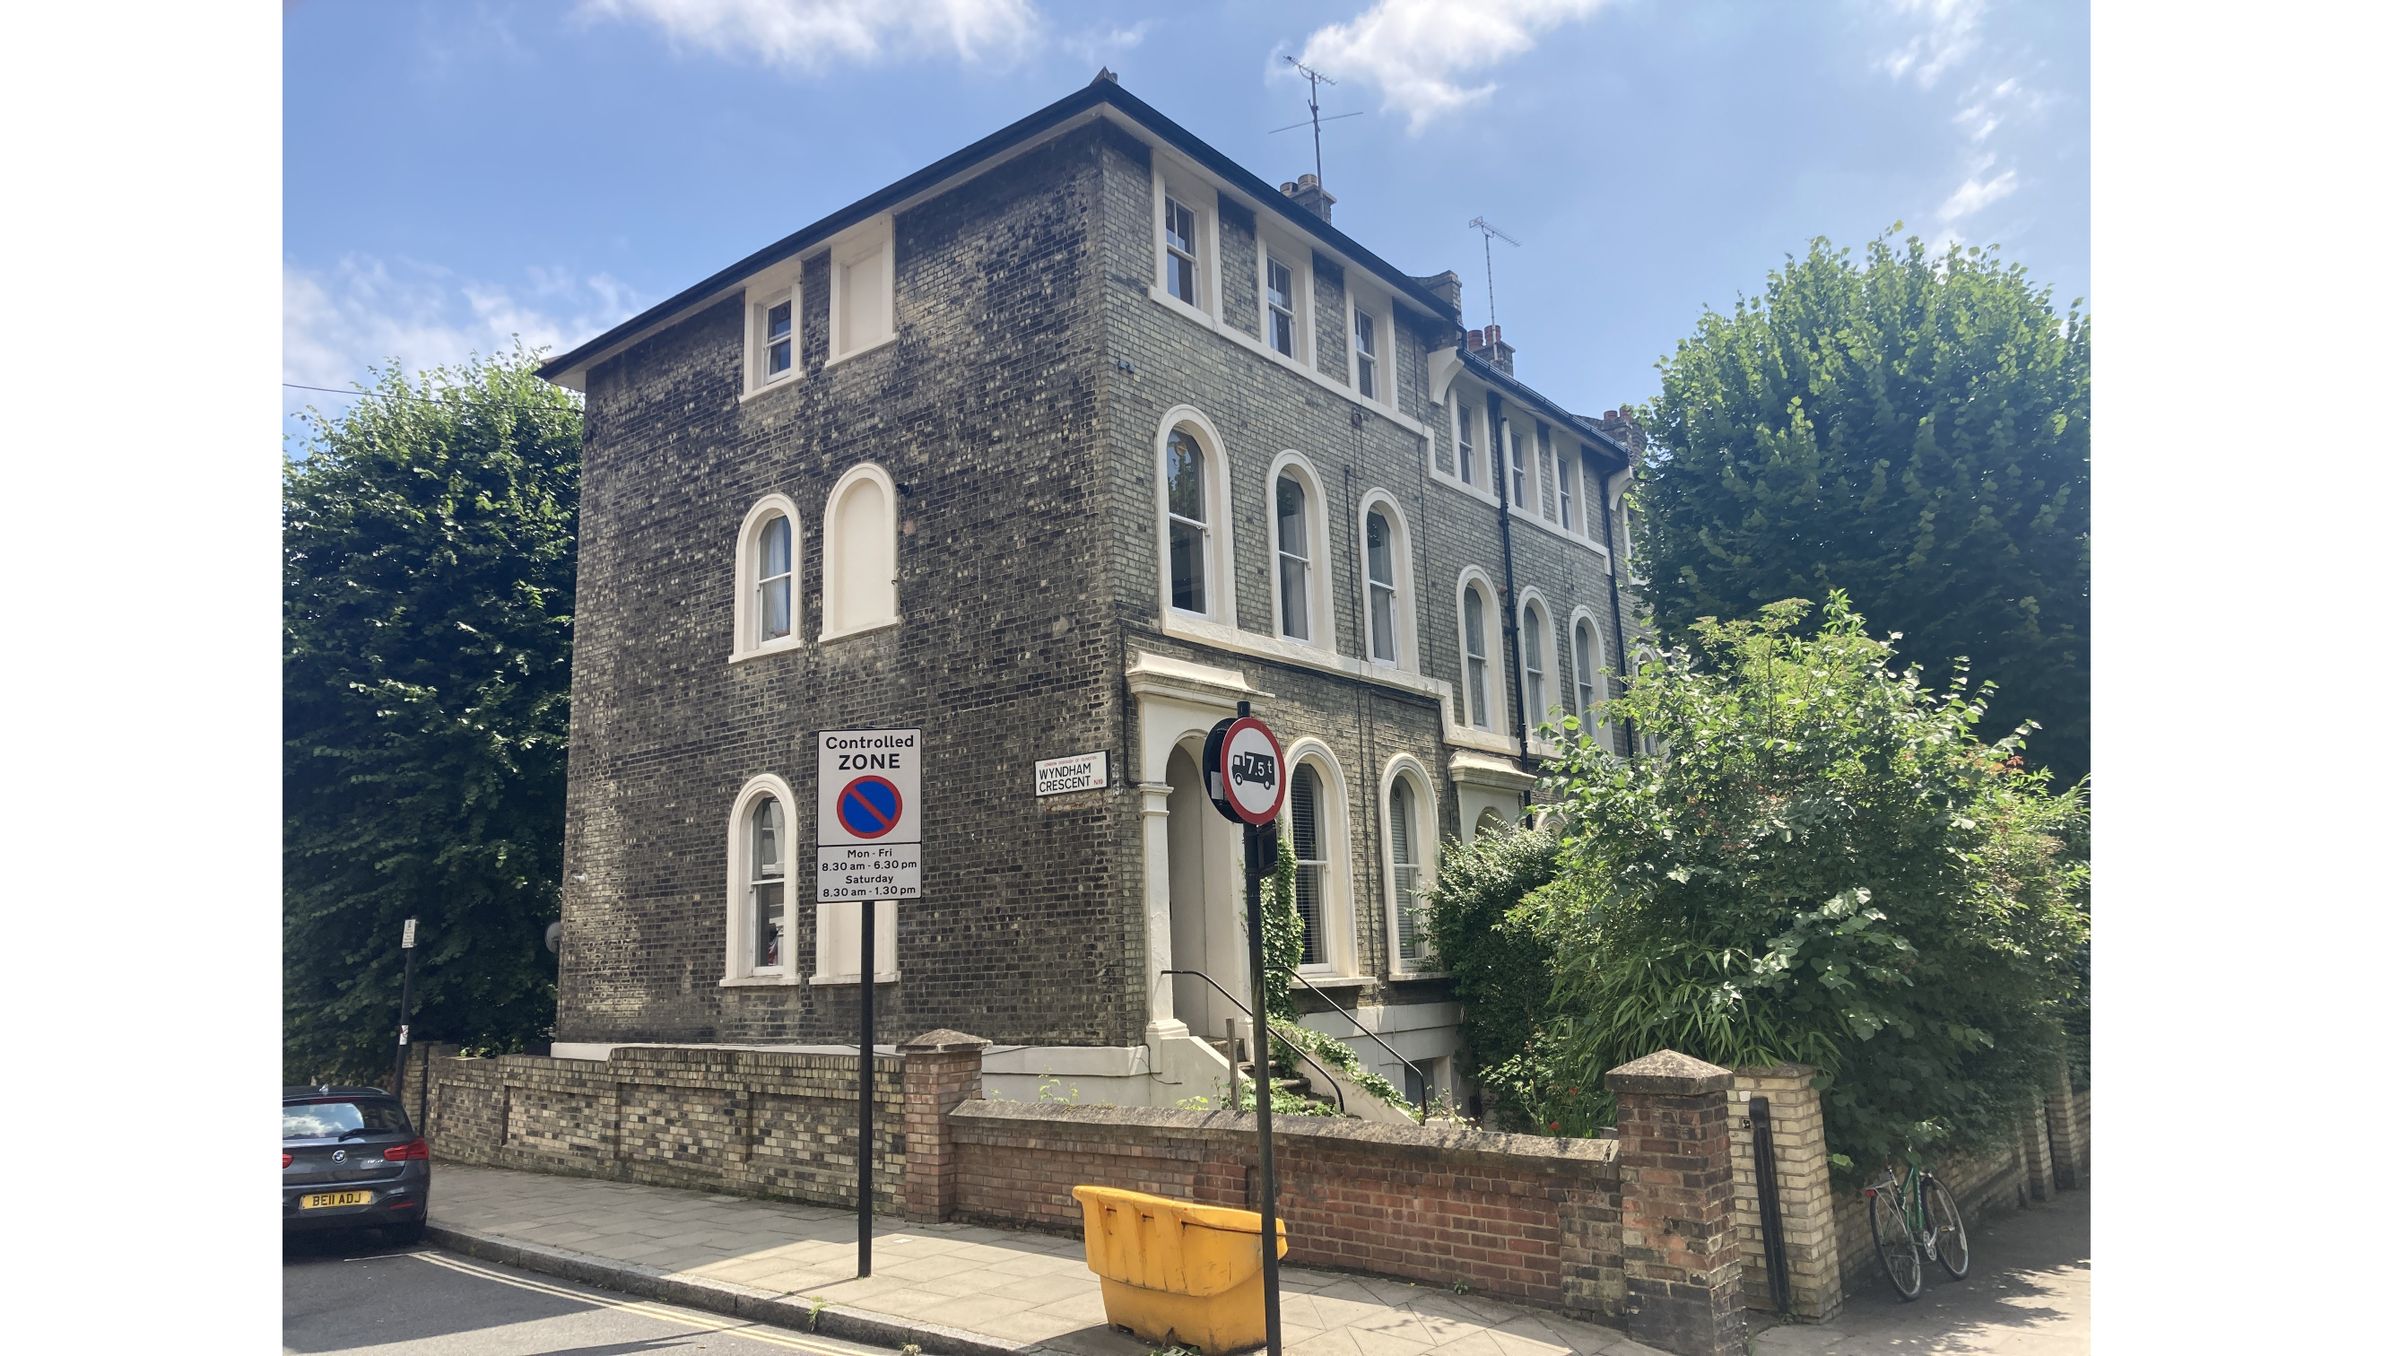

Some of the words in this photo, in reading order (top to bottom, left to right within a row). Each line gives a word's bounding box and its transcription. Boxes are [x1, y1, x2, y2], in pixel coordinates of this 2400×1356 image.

[826, 735, 914, 749] Controlled
[838, 753, 900, 770] ZONE
[1039, 763, 1091, 780] WYNDHAM
[1039, 776, 1090, 792] CRESCENT
[847, 850, 870, 858] Mon
[878, 849, 892, 857] Fri
[822, 862, 847, 871] 8.30
[874, 860, 898, 869] 6.30
[901, 861, 917, 870] pm
[845, 875, 893, 884] Saturday
[823, 888, 848, 897] 8.30
[875, 886, 898, 895] 1.30
[900, 887, 915, 895] pm
[338, 1194, 361, 1204] ADJ
